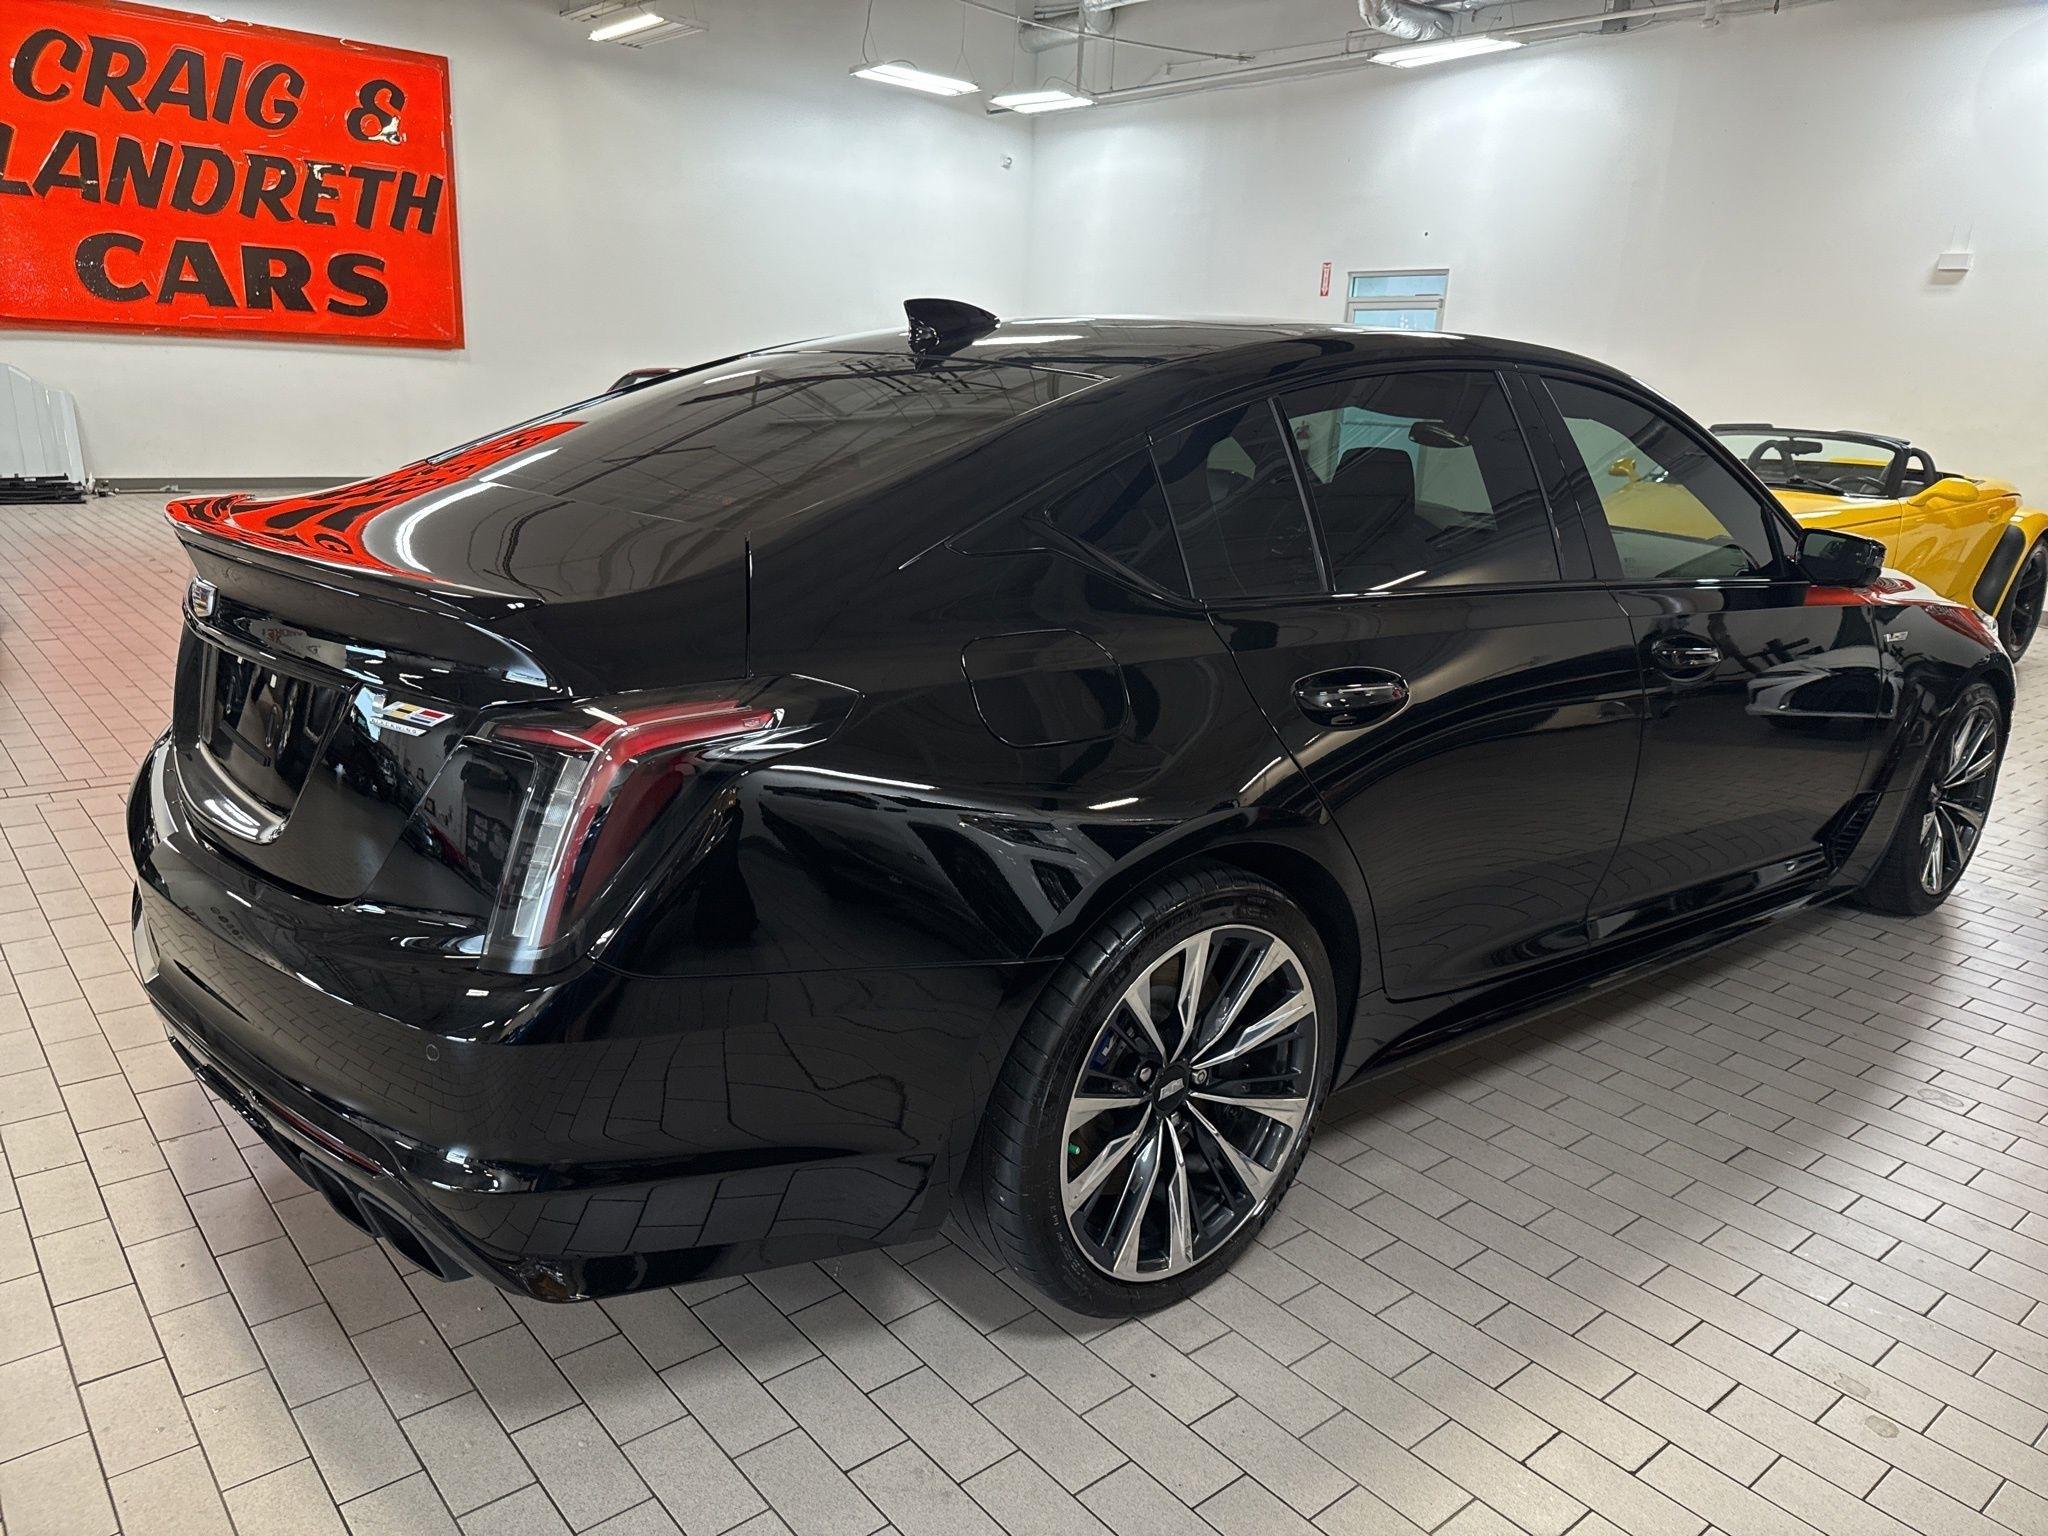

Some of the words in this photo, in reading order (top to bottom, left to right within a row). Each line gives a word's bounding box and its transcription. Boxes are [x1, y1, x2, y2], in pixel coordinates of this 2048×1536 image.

[12, 28, 305, 130] CRAIG
[346, 79, 406, 145] &
[74, 232, 389, 317] CARS
